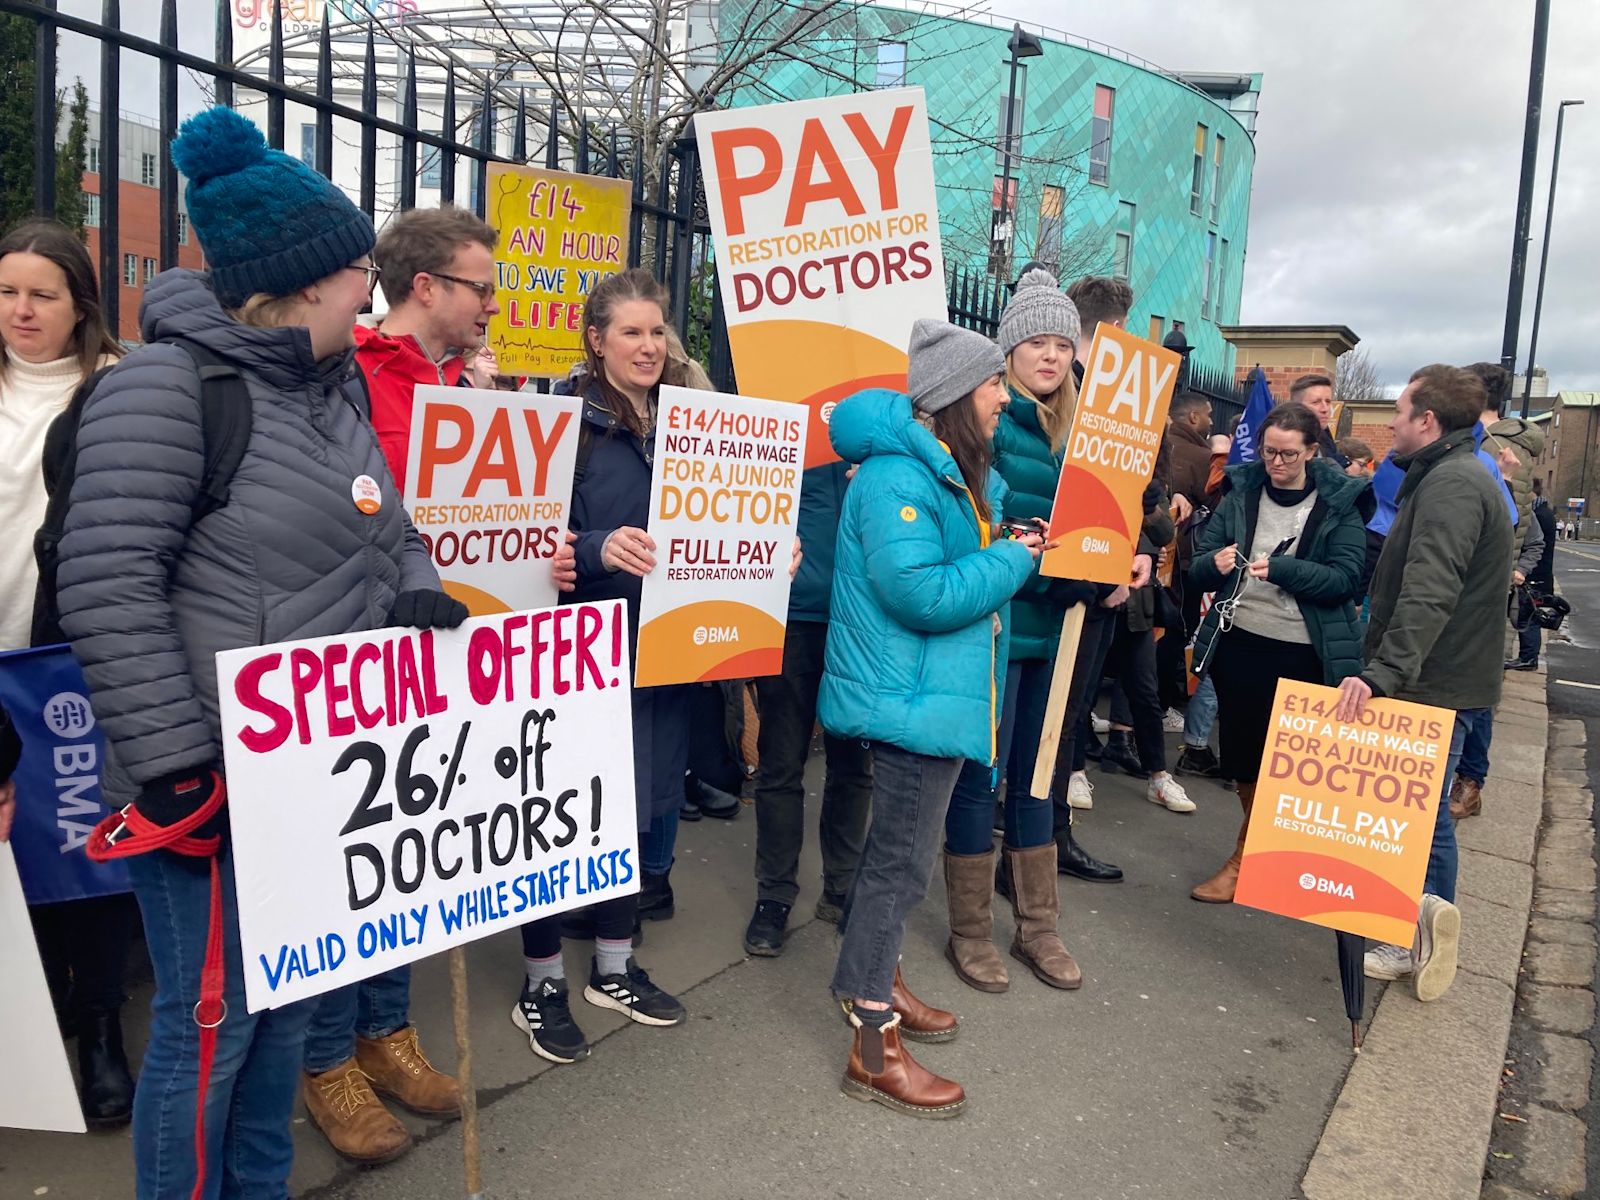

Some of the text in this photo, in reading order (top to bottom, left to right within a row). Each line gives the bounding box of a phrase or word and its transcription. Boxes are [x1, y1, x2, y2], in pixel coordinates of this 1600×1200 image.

[711, 105, 915, 236] PAY
[529, 181, 584, 221] £14
[508, 228, 621, 264] AN HOUR
[729, 212, 929, 266] RESTORATION FOR
[496, 262, 520, 290] TO
[526, 265, 566, 293] SAVE
[733, 241, 932, 313] DOCTORS
[508, 300, 583, 331] LIFE
[500, 352, 581, 366] Full Pay Restora
[1084, 336, 1174, 426] PAY
[668, 405, 801, 443] £14/HOUR IS
[1080, 411, 1159, 447] RESTORATION FOR
[416, 402, 574, 499] PAY
[665, 435, 798, 464] NOT A FAIR WAGE
[1072, 432, 1153, 477] DOCTORS
[663, 458, 796, 489] FOR A JUNIOR
[414, 502, 563, 525] RESTORATION FOR
[659, 485, 793, 525] DOCTOR
[669, 539, 778, 565] FULL PAY
[1091, 538, 1110, 555] BMA
[667, 567, 774, 581] RESTORATION NOW
[708, 626, 739, 644] BMA
[234, 603, 622, 753] SPECIAL OFFER!
[1278, 713, 1439, 760] NOT A FAIR WAGE
[1284, 693, 1442, 741] £14/OUR IS
[331, 708, 556, 836] 26% off
[1275, 731, 1436, 780] FOR A JUNIOR
[53, 744, 101, 855] BMA
[1268, 751, 1431, 812] DOCTOR
[1273, 816, 1404, 856] RESTORATION NOW
[1276, 793, 1409, 842] FULL PAY
[1316, 876, 1355, 901] BMA
[259, 848, 634, 991] VALID ONLY WHILE STAFF LASTS
